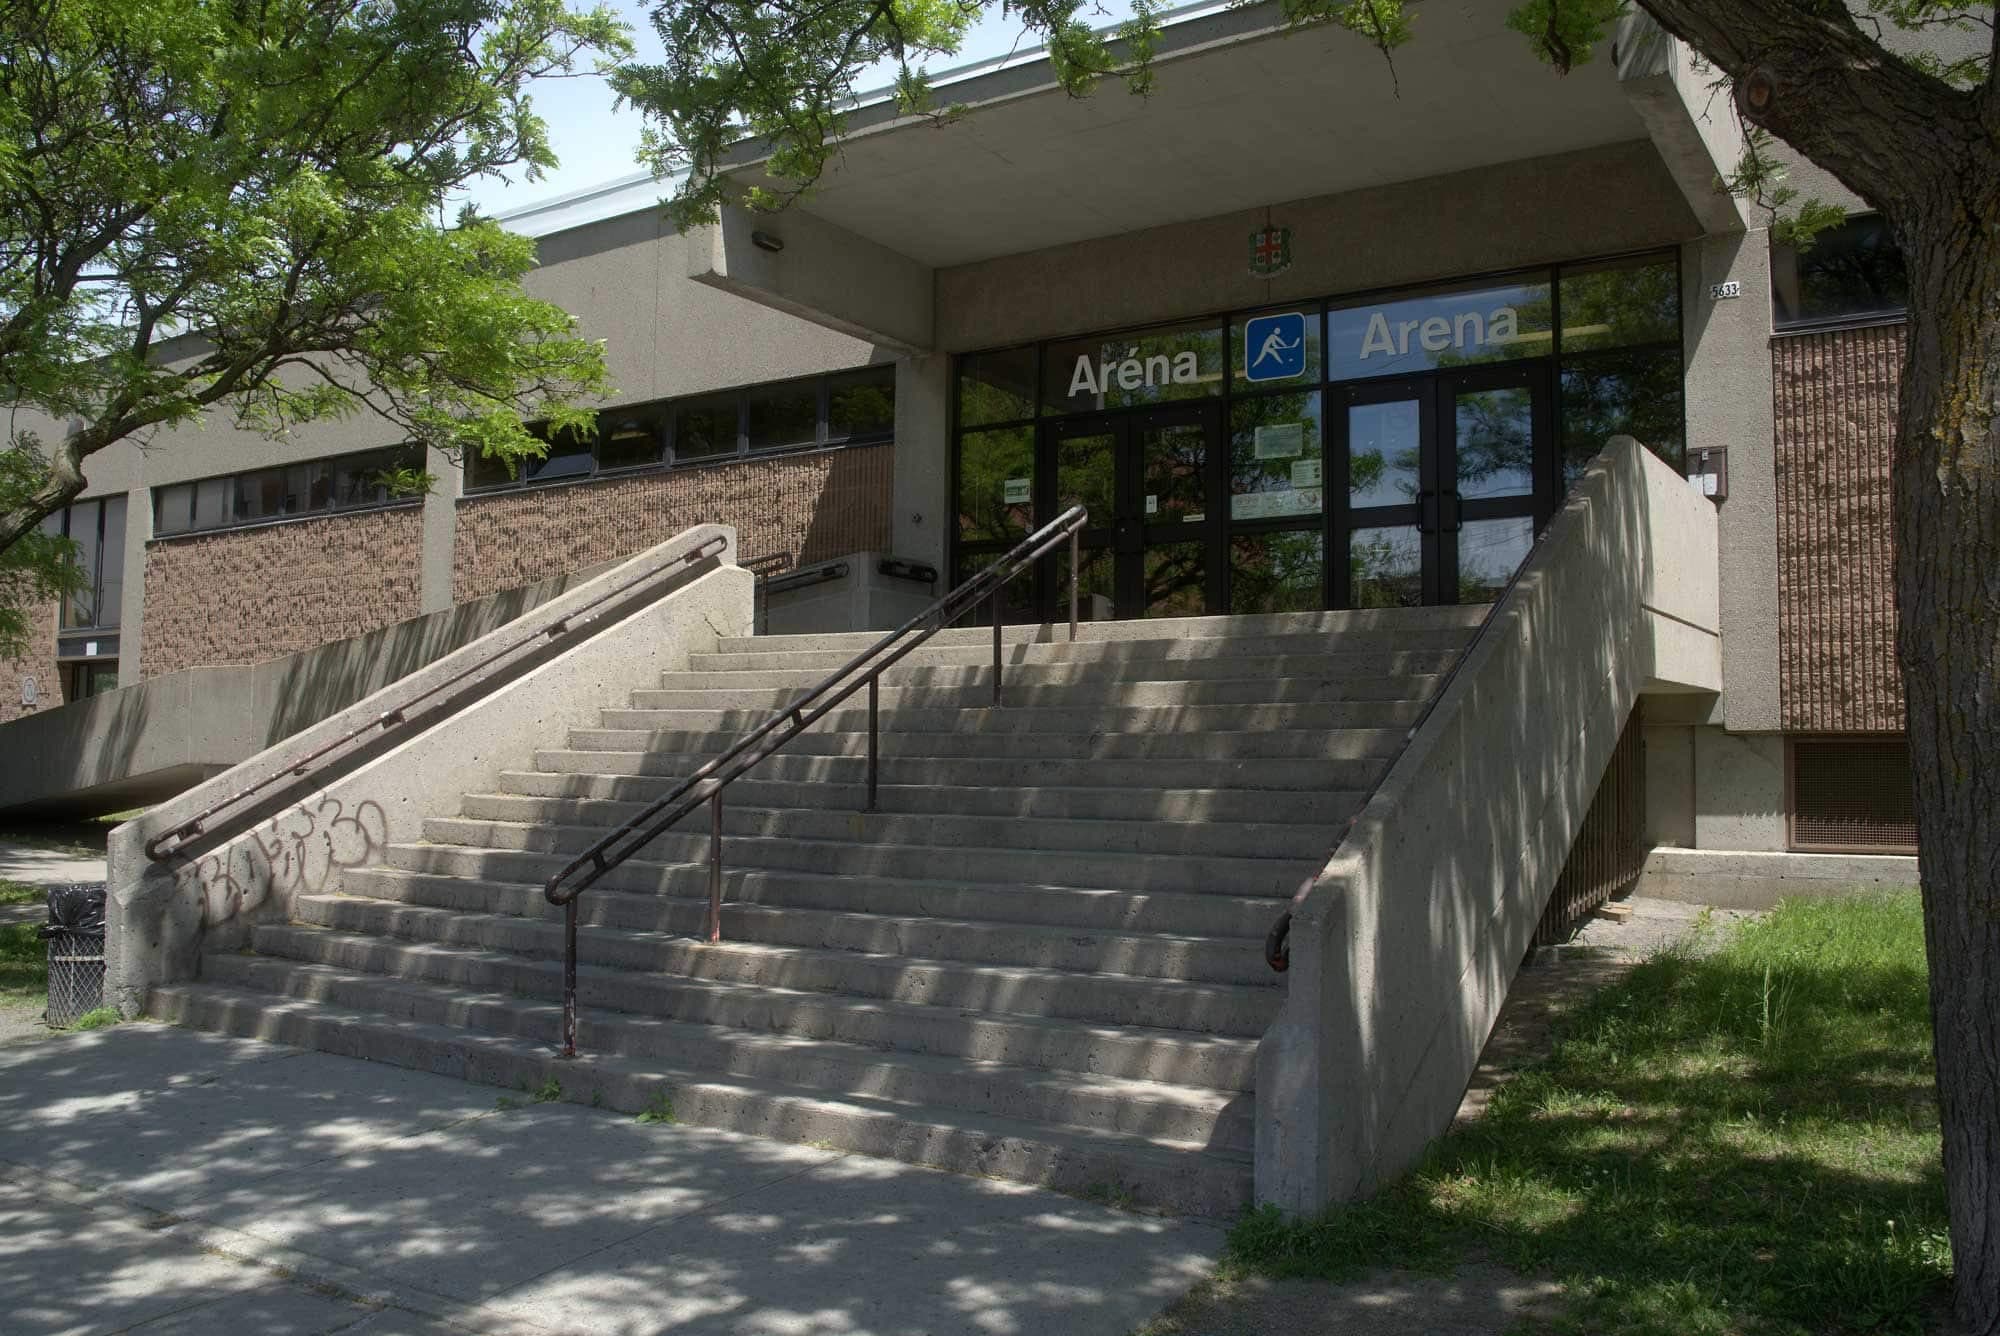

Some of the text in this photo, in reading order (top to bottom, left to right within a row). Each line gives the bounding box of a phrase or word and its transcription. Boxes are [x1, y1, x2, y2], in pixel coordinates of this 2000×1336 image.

[1712, 284, 1737, 298] 5633
[1360, 306, 1519, 360] Arena
[1067, 347, 1198, 397] Aréna
